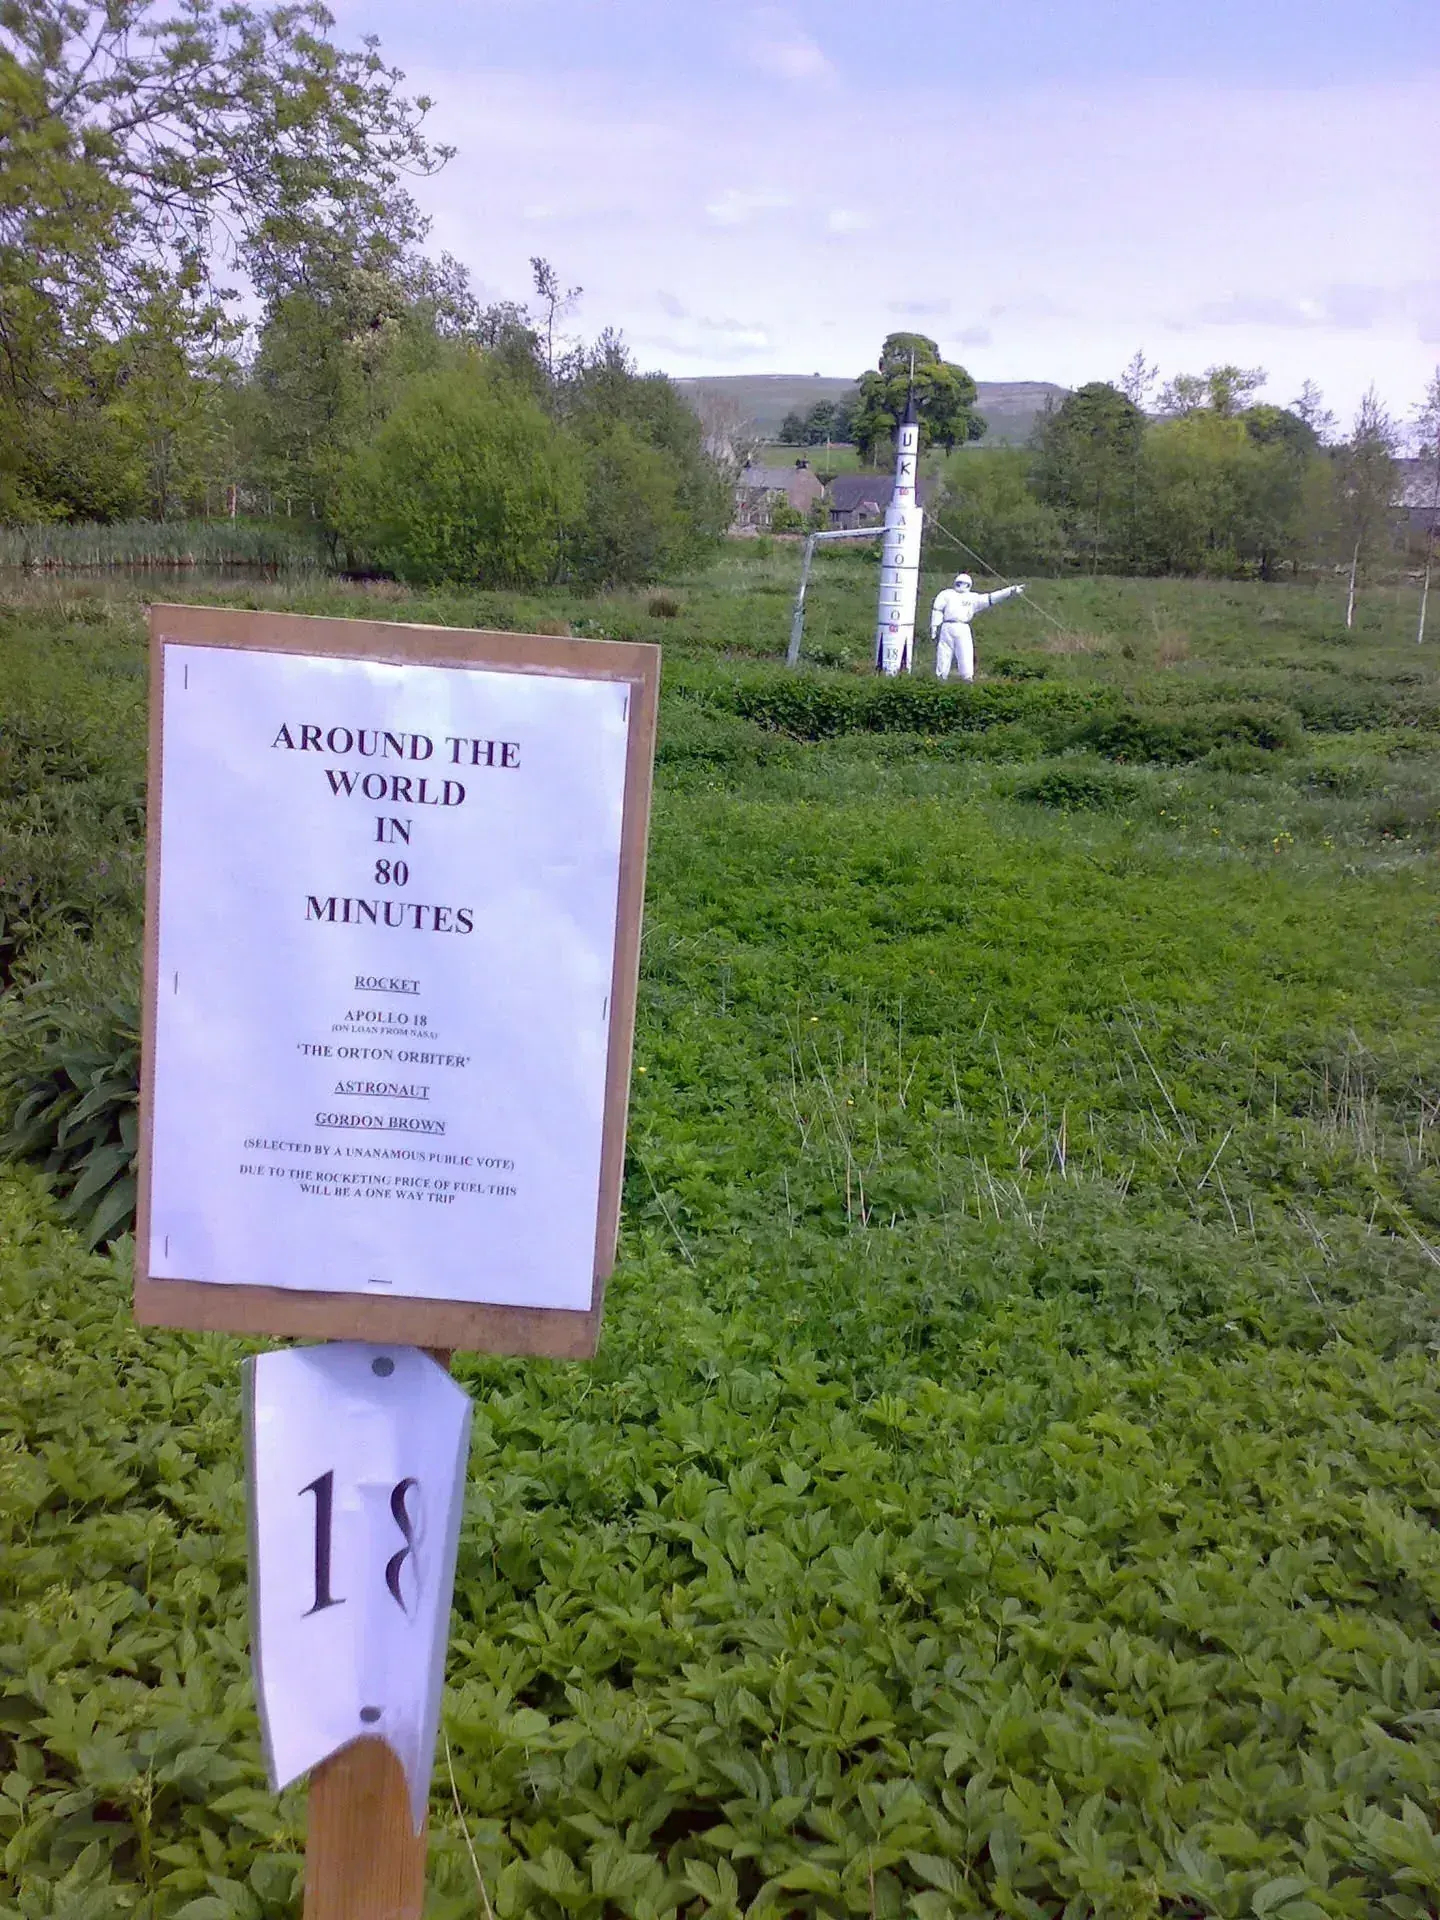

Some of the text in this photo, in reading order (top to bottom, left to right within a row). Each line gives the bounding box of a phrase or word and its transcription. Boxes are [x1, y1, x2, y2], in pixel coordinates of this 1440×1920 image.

[890, 514, 907, 621] APOLLO
[886, 647, 898, 660] 18
[271, 722, 521, 769] AROUND THE
[324, 769, 466, 807] WORLD
[374, 817, 412, 845] IN
[374, 859, 409, 887] 80
[304, 895, 475, 935] MINUTES
[354, 975, 421, 994] ROCKET
[331, 1023, 349, 1033] (ON
[351, 1025, 378, 1035] LOAN
[381, 1027, 409, 1037] FROM
[344, 1009, 428, 1026] APOLLO 18
[338, 1046, 393, 1061] ORTON
[334, 1080, 430, 1100] ASTRONAUT
[315, 1111, 446, 1135] GORDON BROWN
[243, 1138, 514, 1171] (SELECTED BY A UNANAMOUS PUBLIC VOTE)
[239, 1164, 517, 1196] DUE TO THE ROCKETING PRICE OF FUEL THIS
[299, 1183, 455, 1204] WILL BE A ONE WAY TRIP
[297, 1468, 426, 1624] 18
